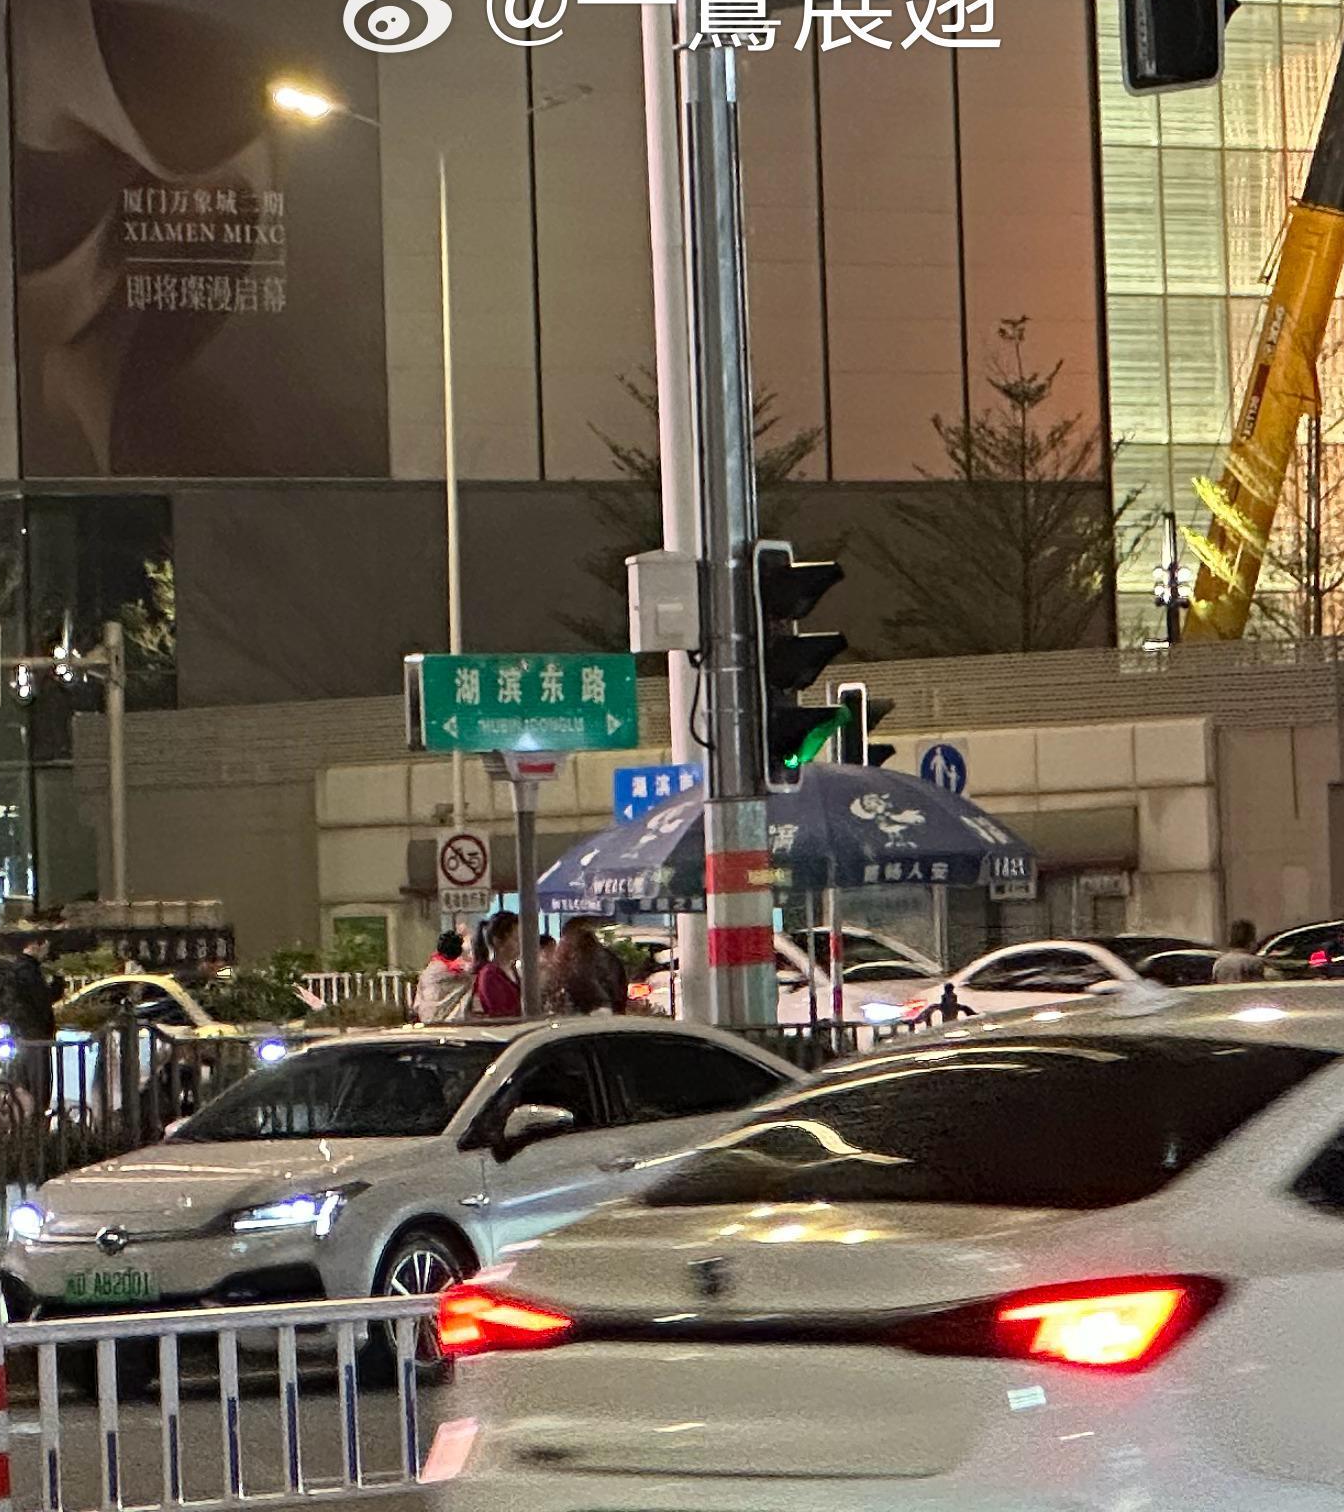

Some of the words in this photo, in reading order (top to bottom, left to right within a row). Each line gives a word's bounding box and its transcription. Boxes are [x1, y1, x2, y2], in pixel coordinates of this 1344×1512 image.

[123, 187, 284, 216] 厦门万象城二期
[124, 221, 215, 242] XIAMEN
[223, 223, 286, 245] MIXC
[455, 663, 606, 705] 湖滨东路
